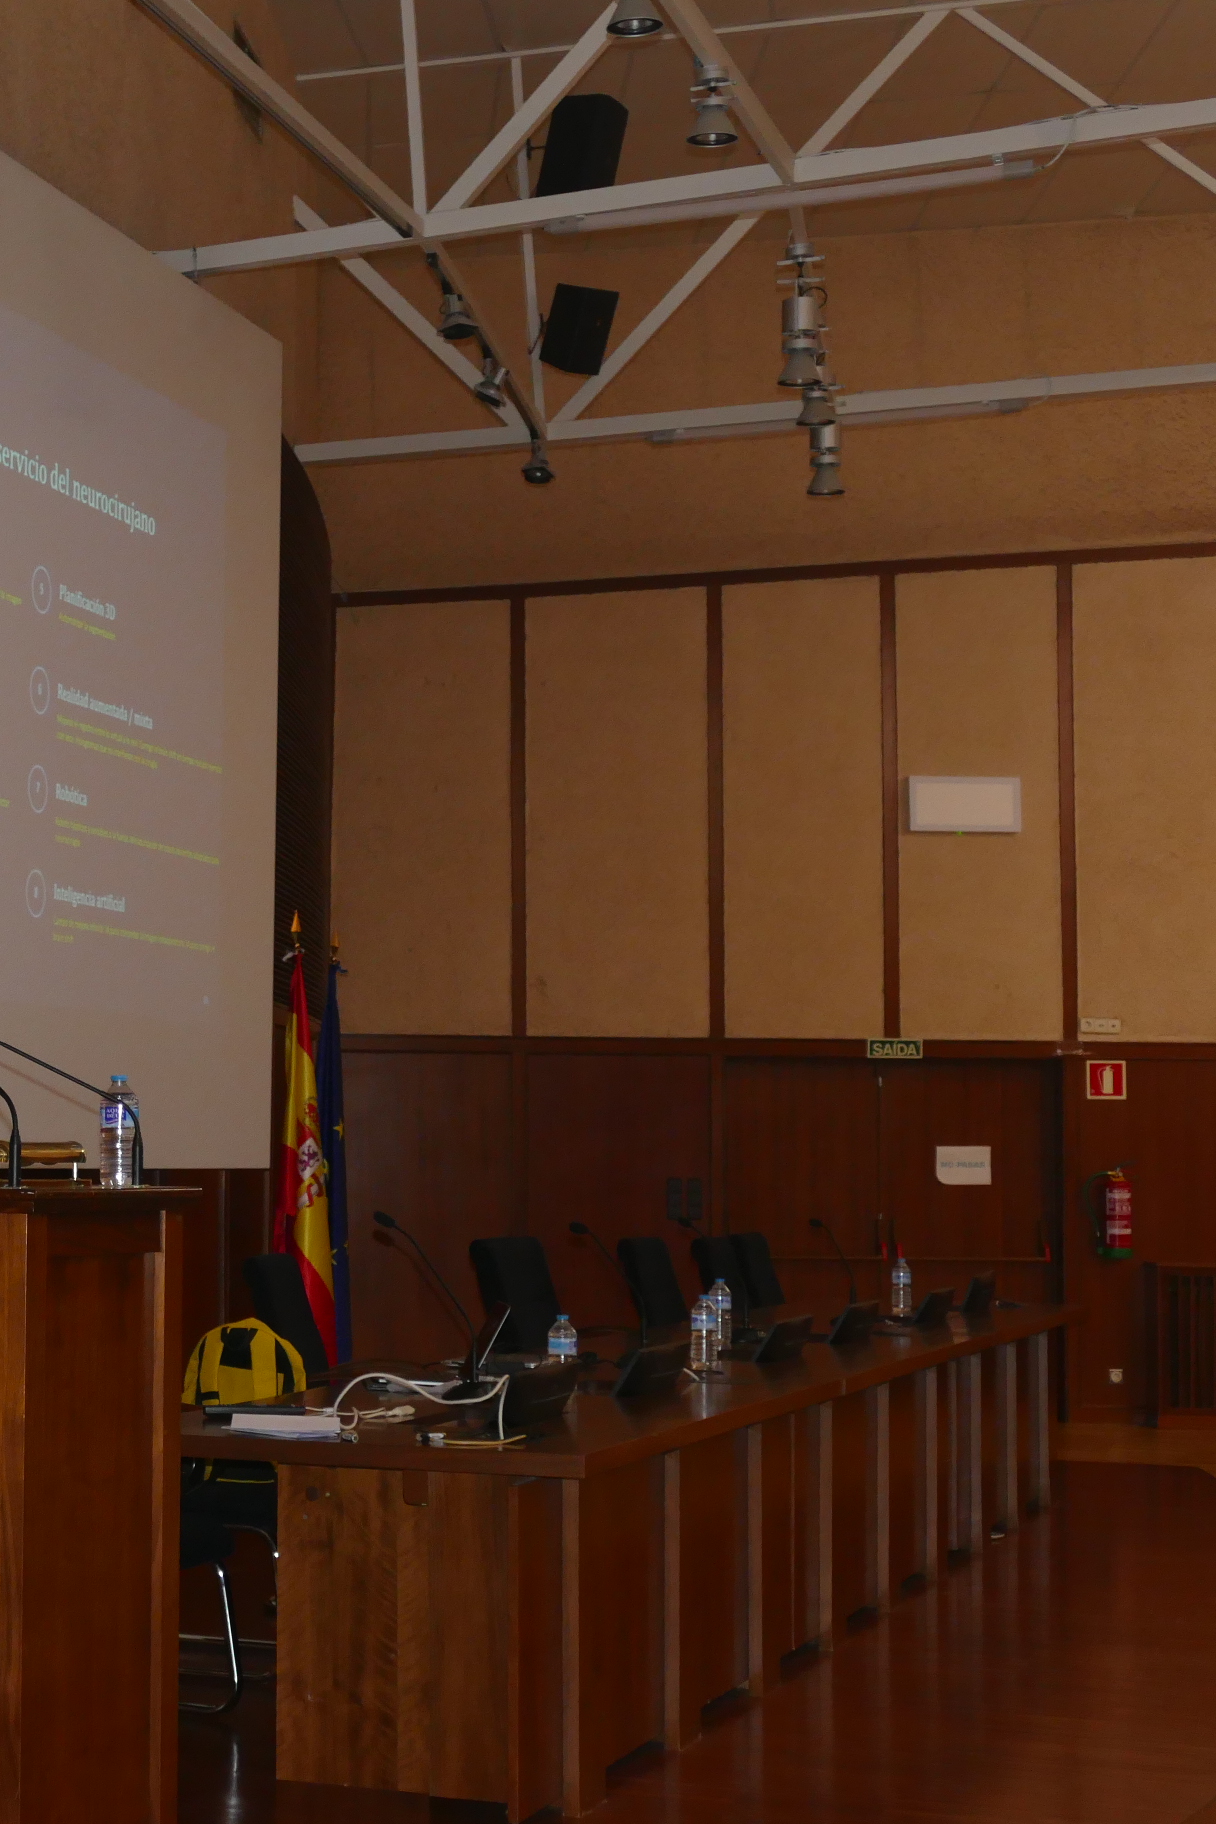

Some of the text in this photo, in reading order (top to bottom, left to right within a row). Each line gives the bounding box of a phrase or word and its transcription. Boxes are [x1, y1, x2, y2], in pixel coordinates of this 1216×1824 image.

[50, 463, 70, 496] del
[72, 480, 156, 535] neurocirujano
[872, 1041, 918, 1057] SAÍDA
